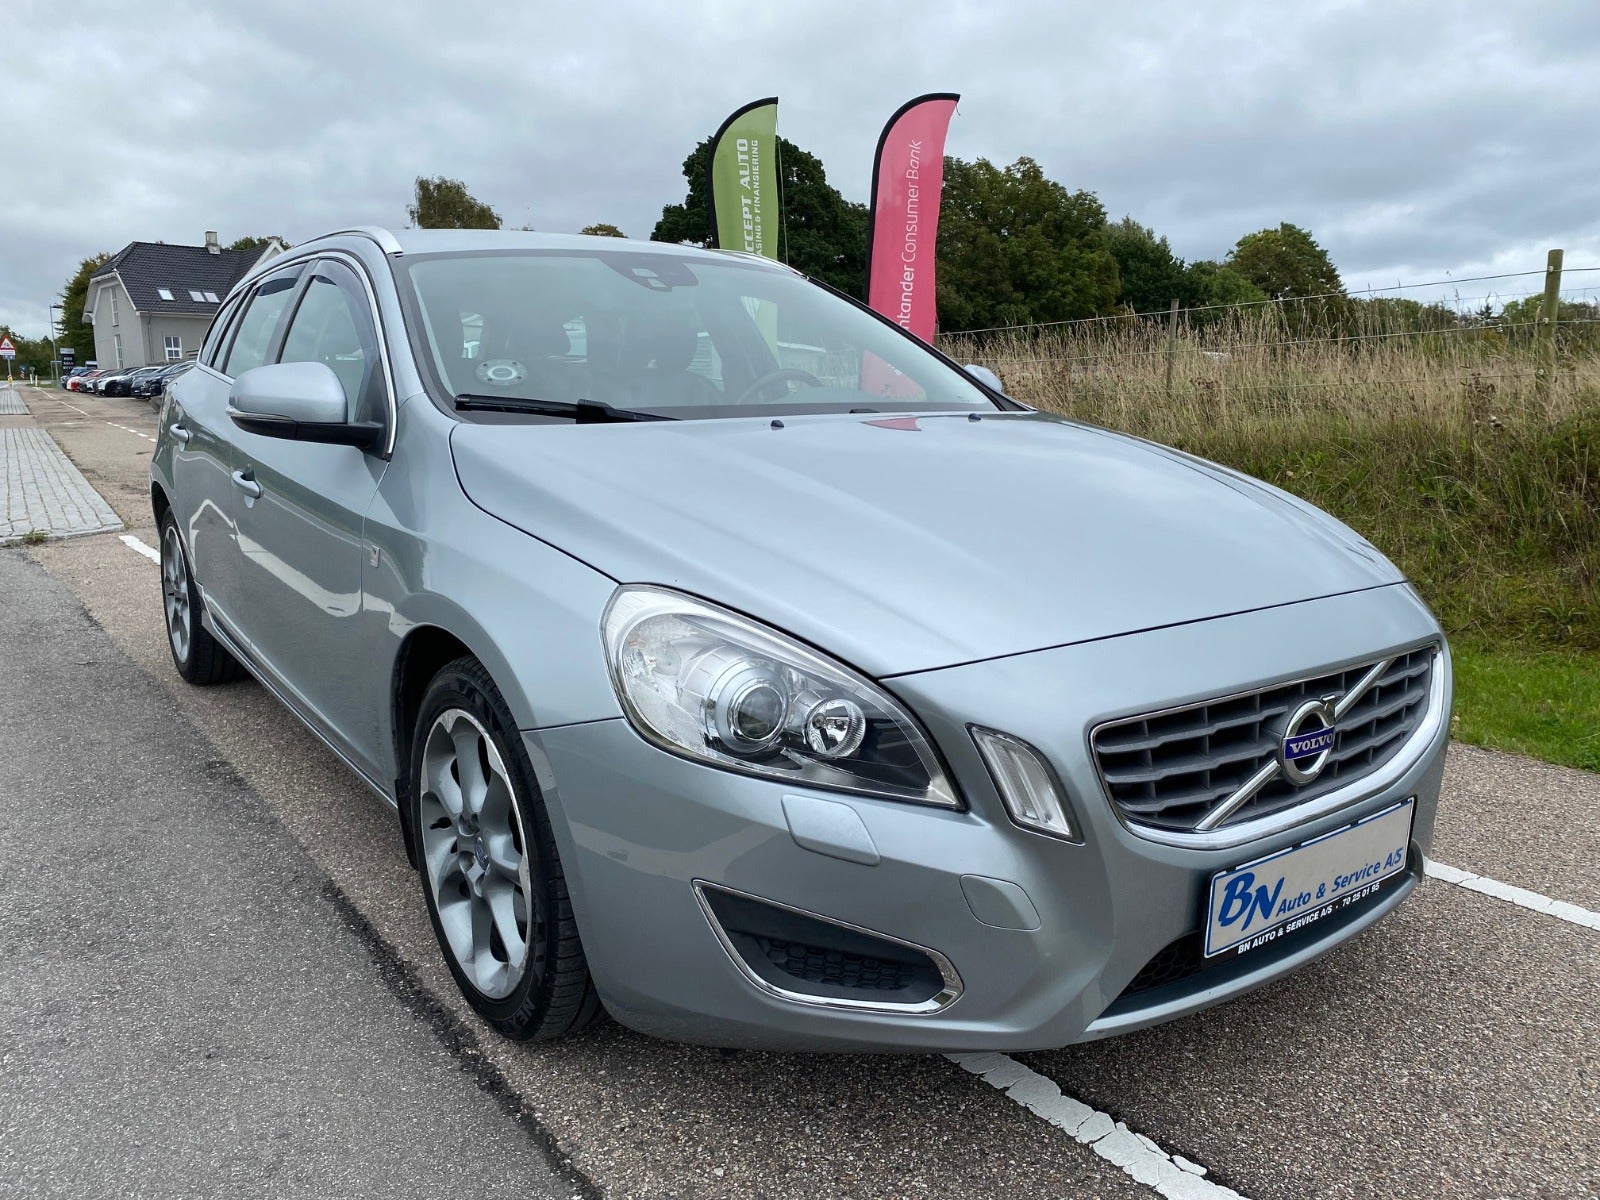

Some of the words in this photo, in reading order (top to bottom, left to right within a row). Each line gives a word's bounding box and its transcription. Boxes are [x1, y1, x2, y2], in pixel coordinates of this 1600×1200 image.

[736, 138, 751, 191] AUTO
[751, 139, 761, 213] FINANSIERING
[905, 139, 922, 180] Bank
[901, 181, 919, 263] Consumer
[1289, 732, 1333, 754] VOLVO
[1218, 872, 1285, 932] BN
[1276, 892, 1311, 917] Auto
[1315, 883, 1326, 900] &
[1331, 861, 1381, 893] Service
[1383, 847, 1404, 870] A/S
[1237, 940, 1251, 954] BN
[1251, 930, 1276, 947] AUTO
[1277, 928, 1284, 937] &
[1285, 912, 1320, 933] SERVICE
[1320, 904, 1333, 917] A/S
[1342, 896, 1351, 908] 70
[1351, 892, 1361, 904] 25
[1361, 888, 1370, 899] 01
